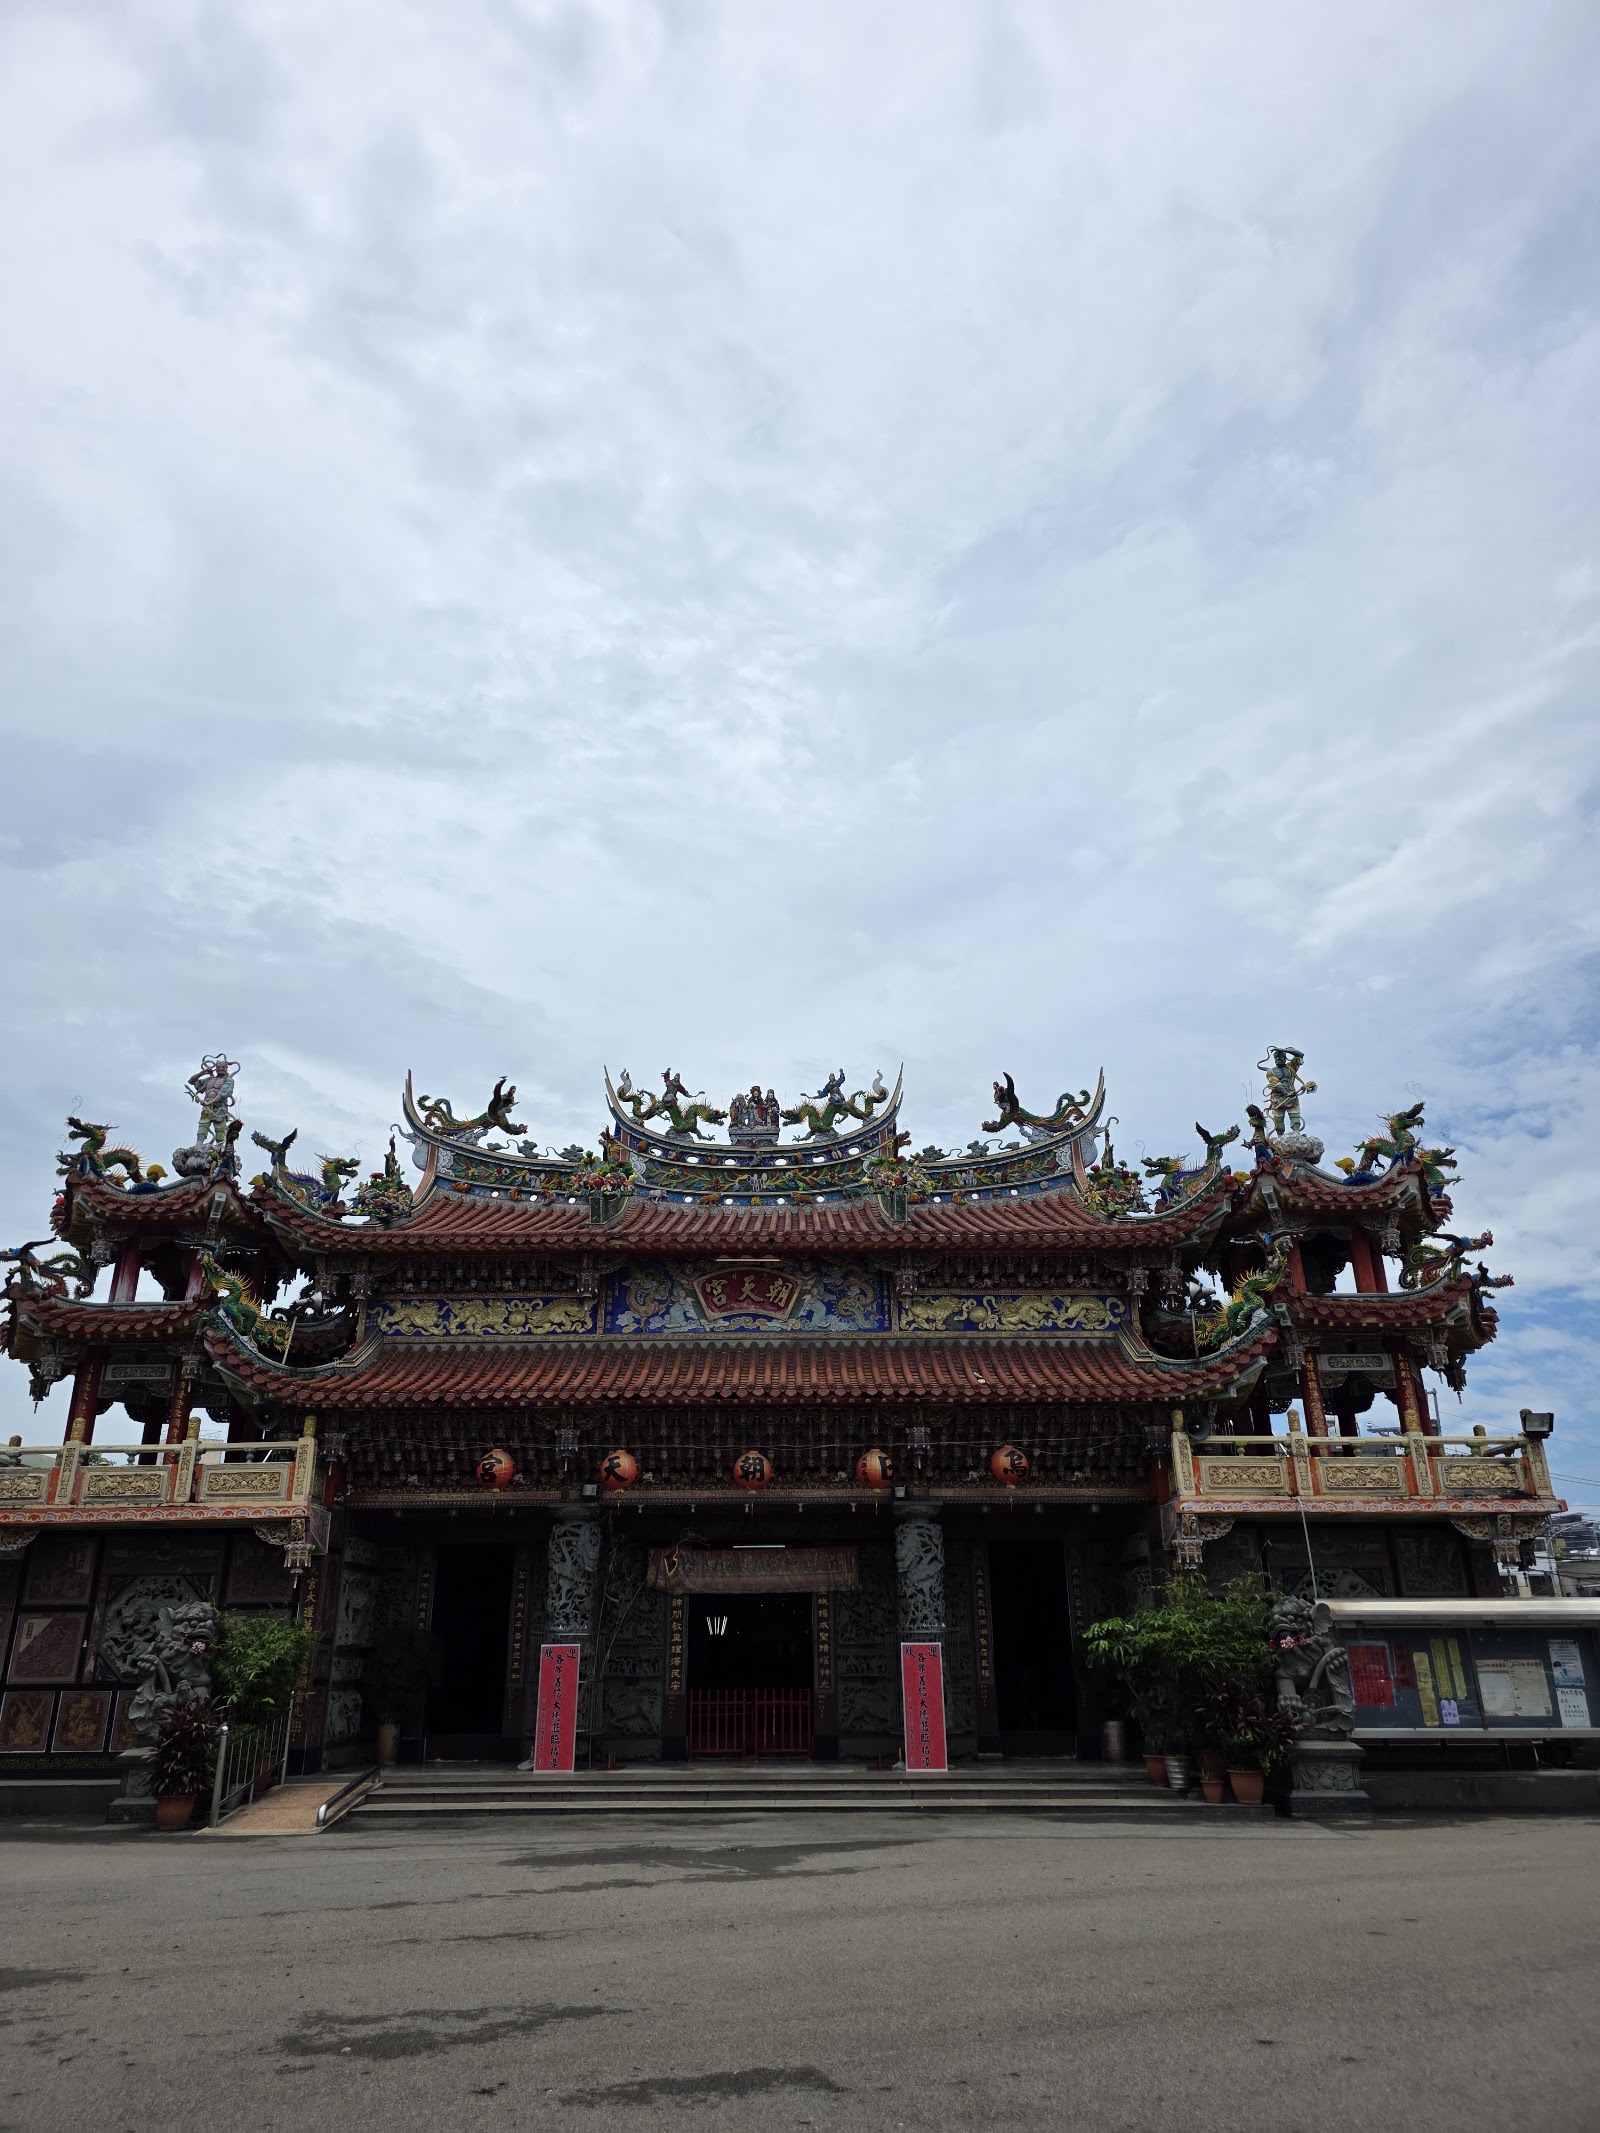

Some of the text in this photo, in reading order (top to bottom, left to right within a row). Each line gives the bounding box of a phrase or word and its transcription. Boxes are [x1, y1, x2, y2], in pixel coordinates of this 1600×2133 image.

[705, 1274, 793, 1307] 朝天宮
[479, 1454, 502, 1483] 宮
[603, 1456, 628, 1482] 天
[739, 1455, 765, 1483] 朝
